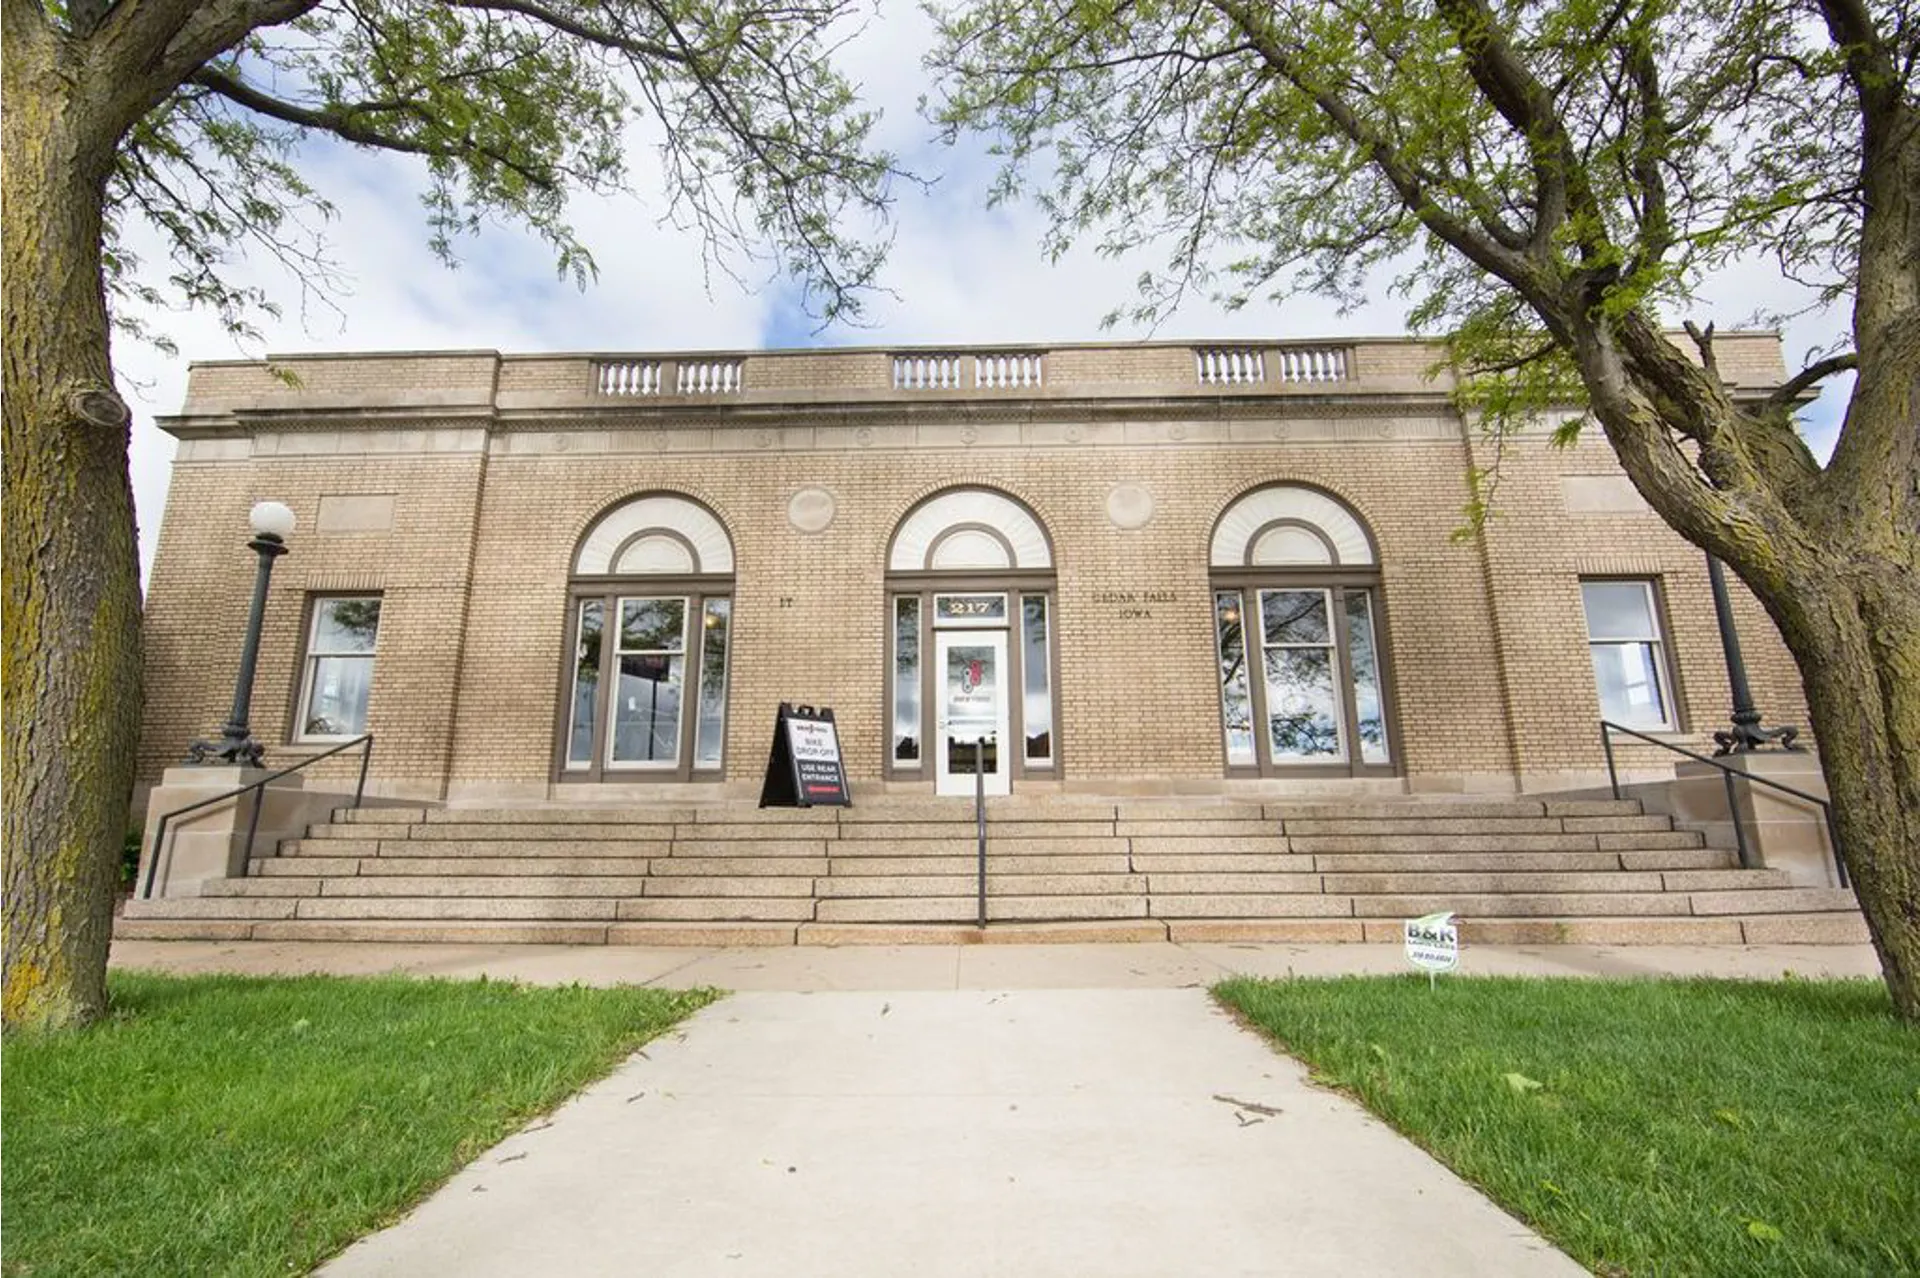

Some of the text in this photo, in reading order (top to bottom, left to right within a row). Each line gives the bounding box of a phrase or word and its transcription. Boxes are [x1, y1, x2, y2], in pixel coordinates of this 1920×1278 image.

[950, 602, 989, 614] 217
[1119, 609, 1152, 619] IOWA
[801, 764, 816, 772] USE
[801, 773, 839, 782] ENTRANCE
[1408, 924, 1454, 942] B&K
